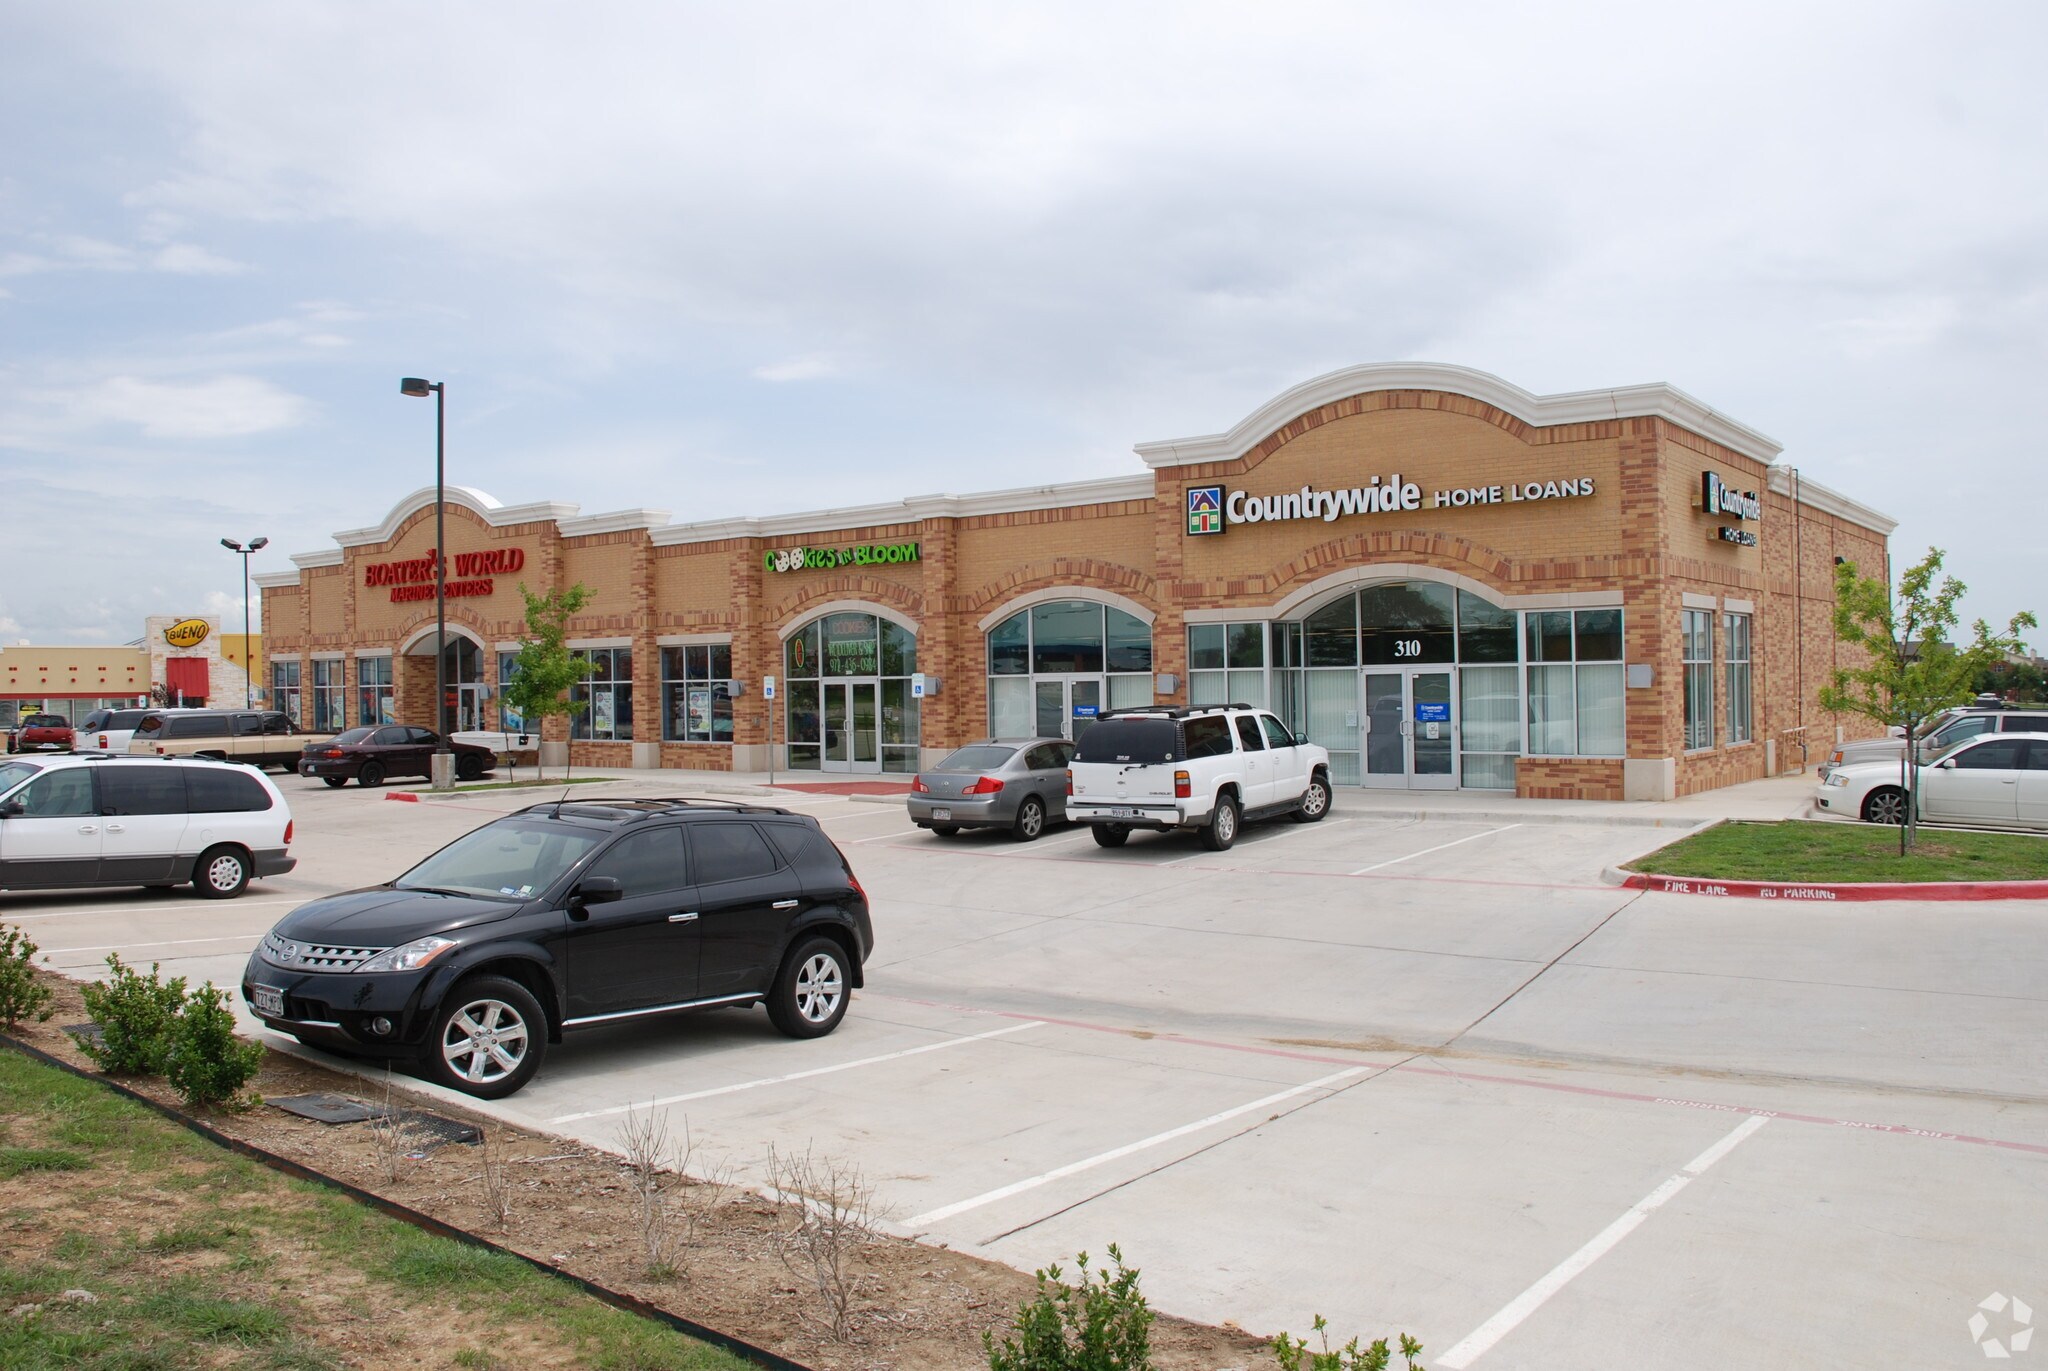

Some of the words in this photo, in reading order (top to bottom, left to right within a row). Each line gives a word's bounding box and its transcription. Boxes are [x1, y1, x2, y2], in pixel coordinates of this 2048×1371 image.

[1226, 473, 1422, 525] Countrywide
[1434, 485, 1504, 509] HOME
[1511, 477, 1596, 502] LOANS
[1719, 482, 1760, 521] Countrywide
[1724, 526, 1741, 543] HOME
[454, 547, 525, 578] WORLD
[855, 543, 919, 566] BLOOM
[390, 584, 436, 602] MARINE
[169, 624, 206, 640] BUENO
[1394, 640, 1421, 657] 310
[1664, 880, 1691, 893] FIRE
[1697, 884, 1729, 896] LANE
[1760, 888, 1777, 898] NO
[1784, 888, 1836, 900] PARKING
